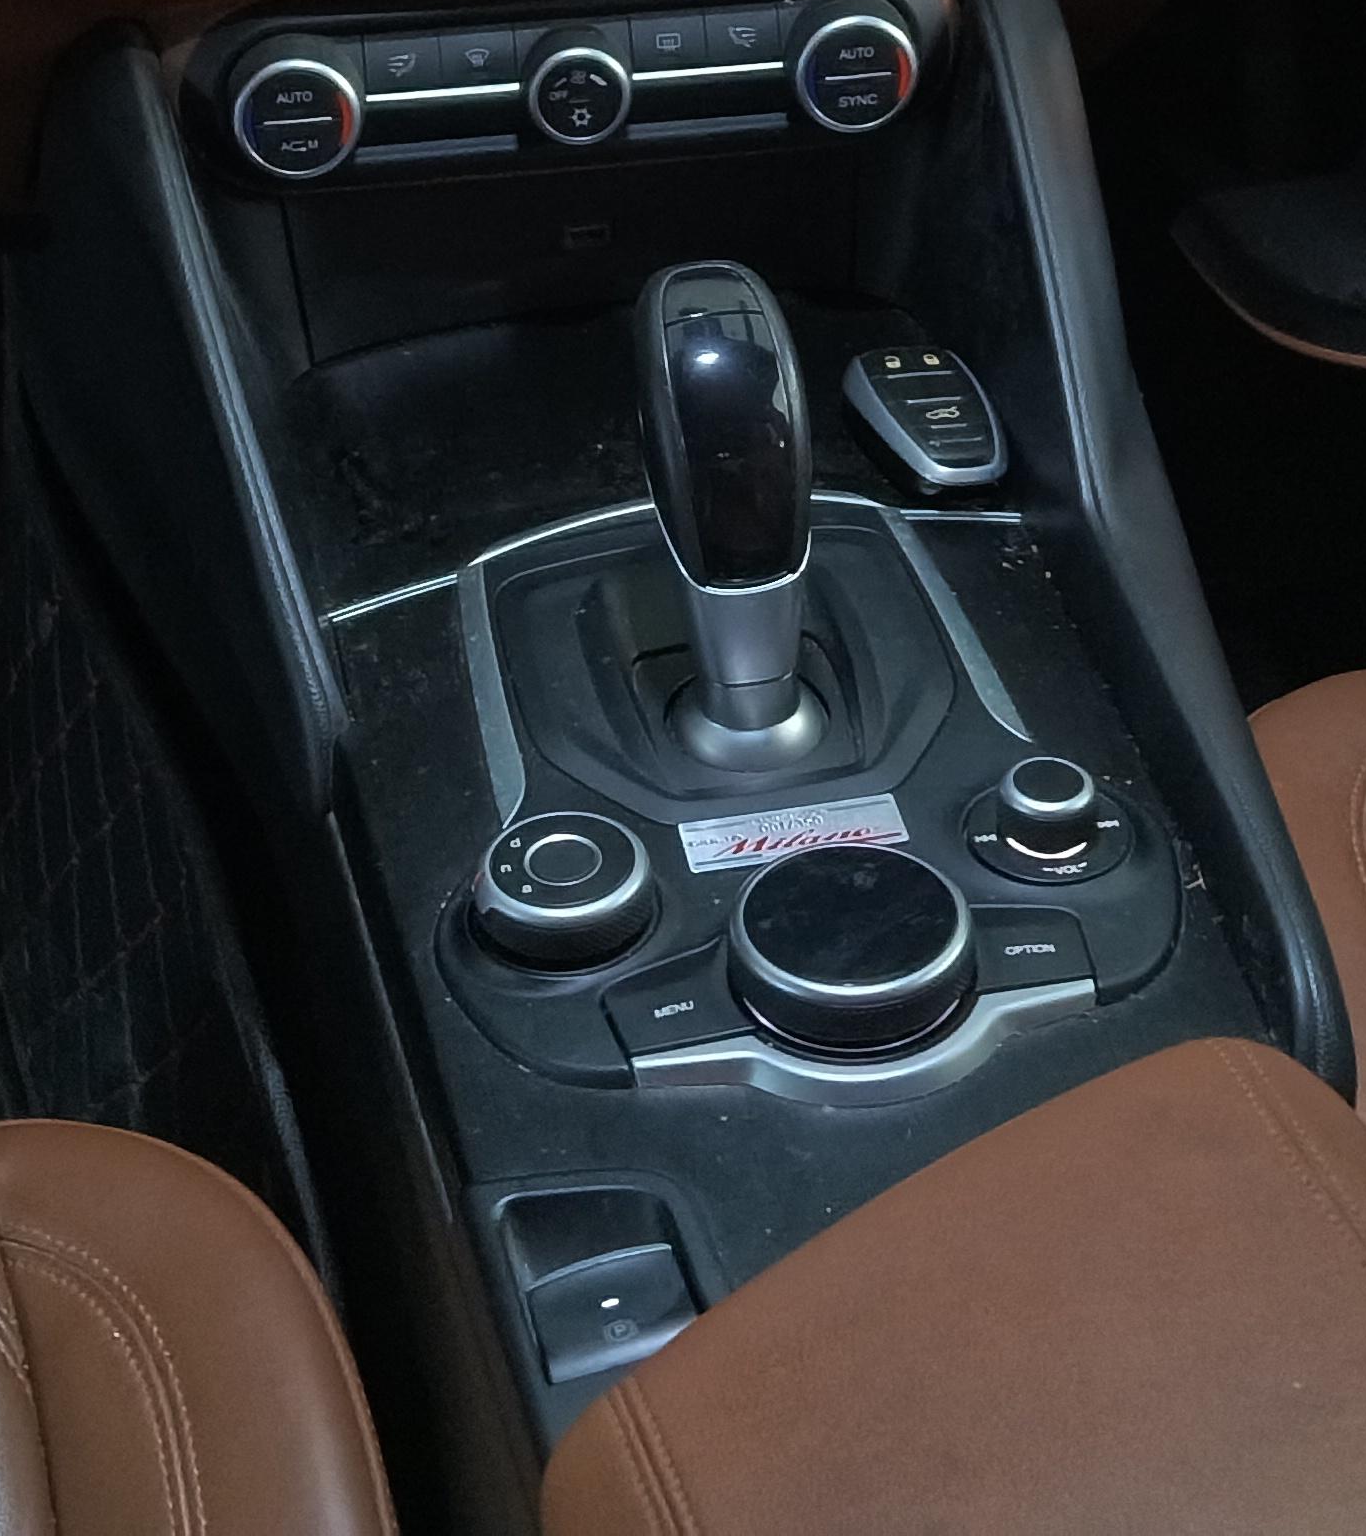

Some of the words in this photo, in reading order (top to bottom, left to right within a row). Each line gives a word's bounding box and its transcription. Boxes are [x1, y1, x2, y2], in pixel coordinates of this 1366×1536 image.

[838, 46, 875, 60] AUTO
[276, 90, 313, 104] AUTO
[838, 93, 878, 108] SYNC
[713, 827, 875, 858] Milano
[1004, 943, 1056, 955] OPTION
[653, 1000, 695, 1019] MENU
